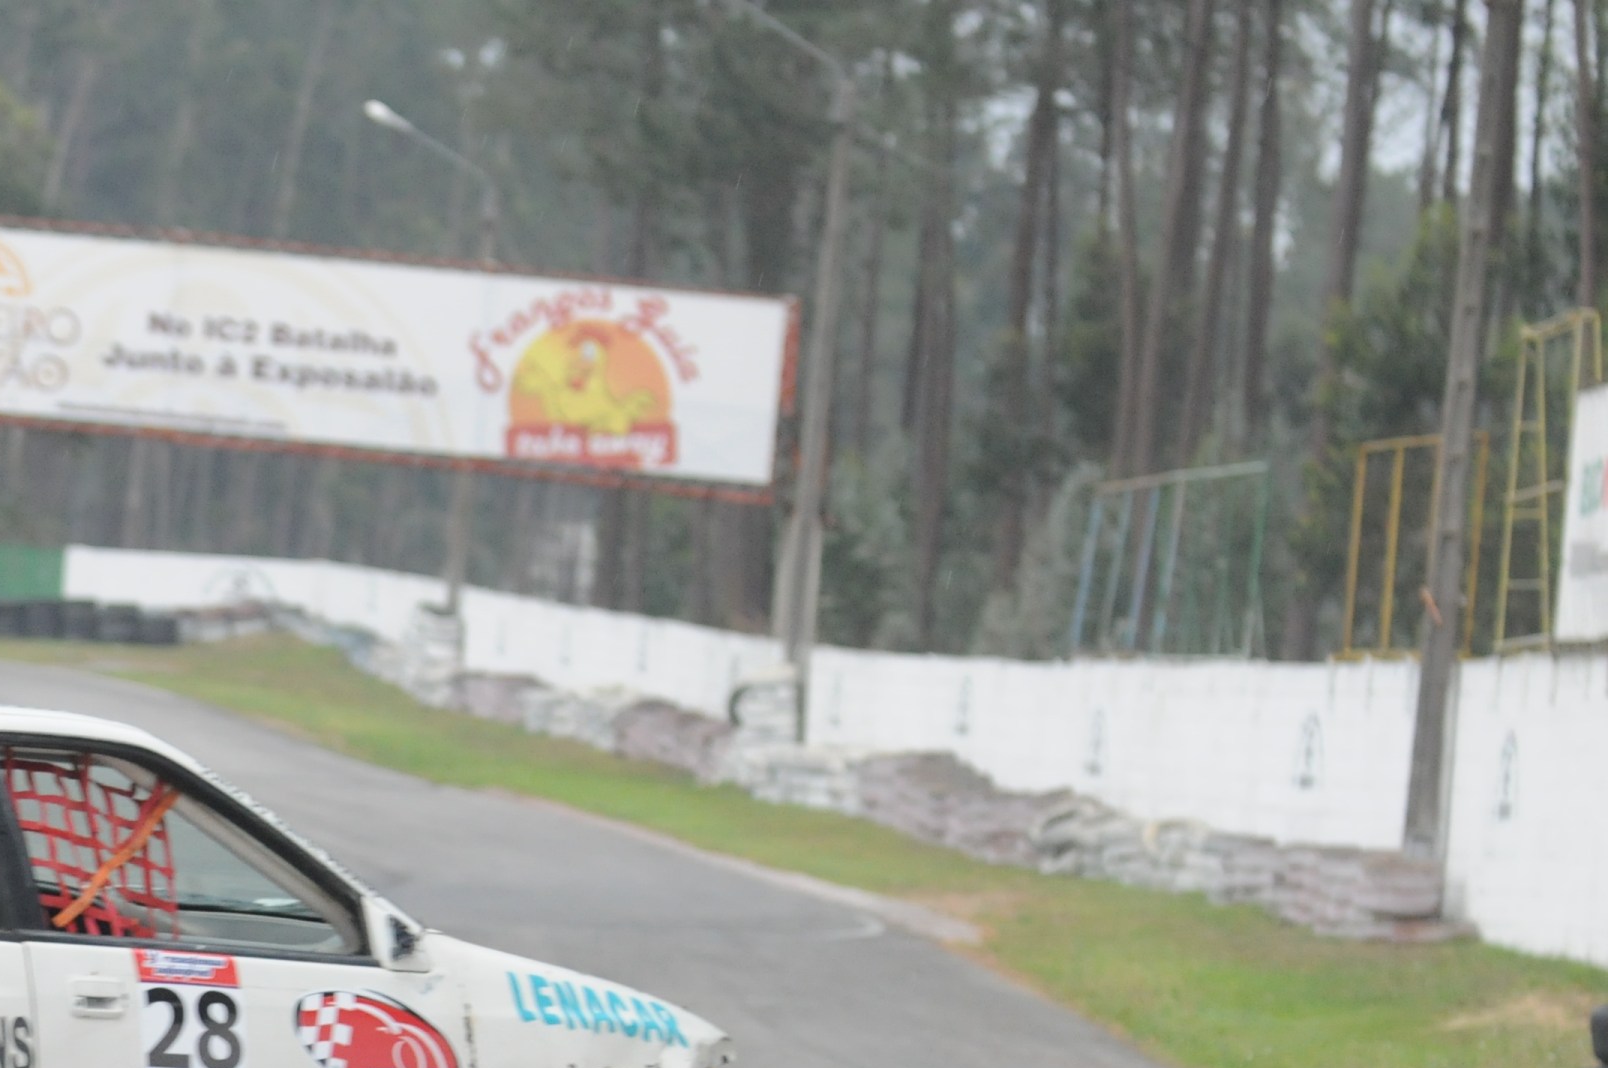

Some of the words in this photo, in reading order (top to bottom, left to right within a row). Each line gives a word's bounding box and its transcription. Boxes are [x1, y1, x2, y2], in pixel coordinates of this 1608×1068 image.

[270, 320, 398, 358] Batalha
[102, 343, 204, 377] Junto
[505, 971, 690, 1048] LENACAR
